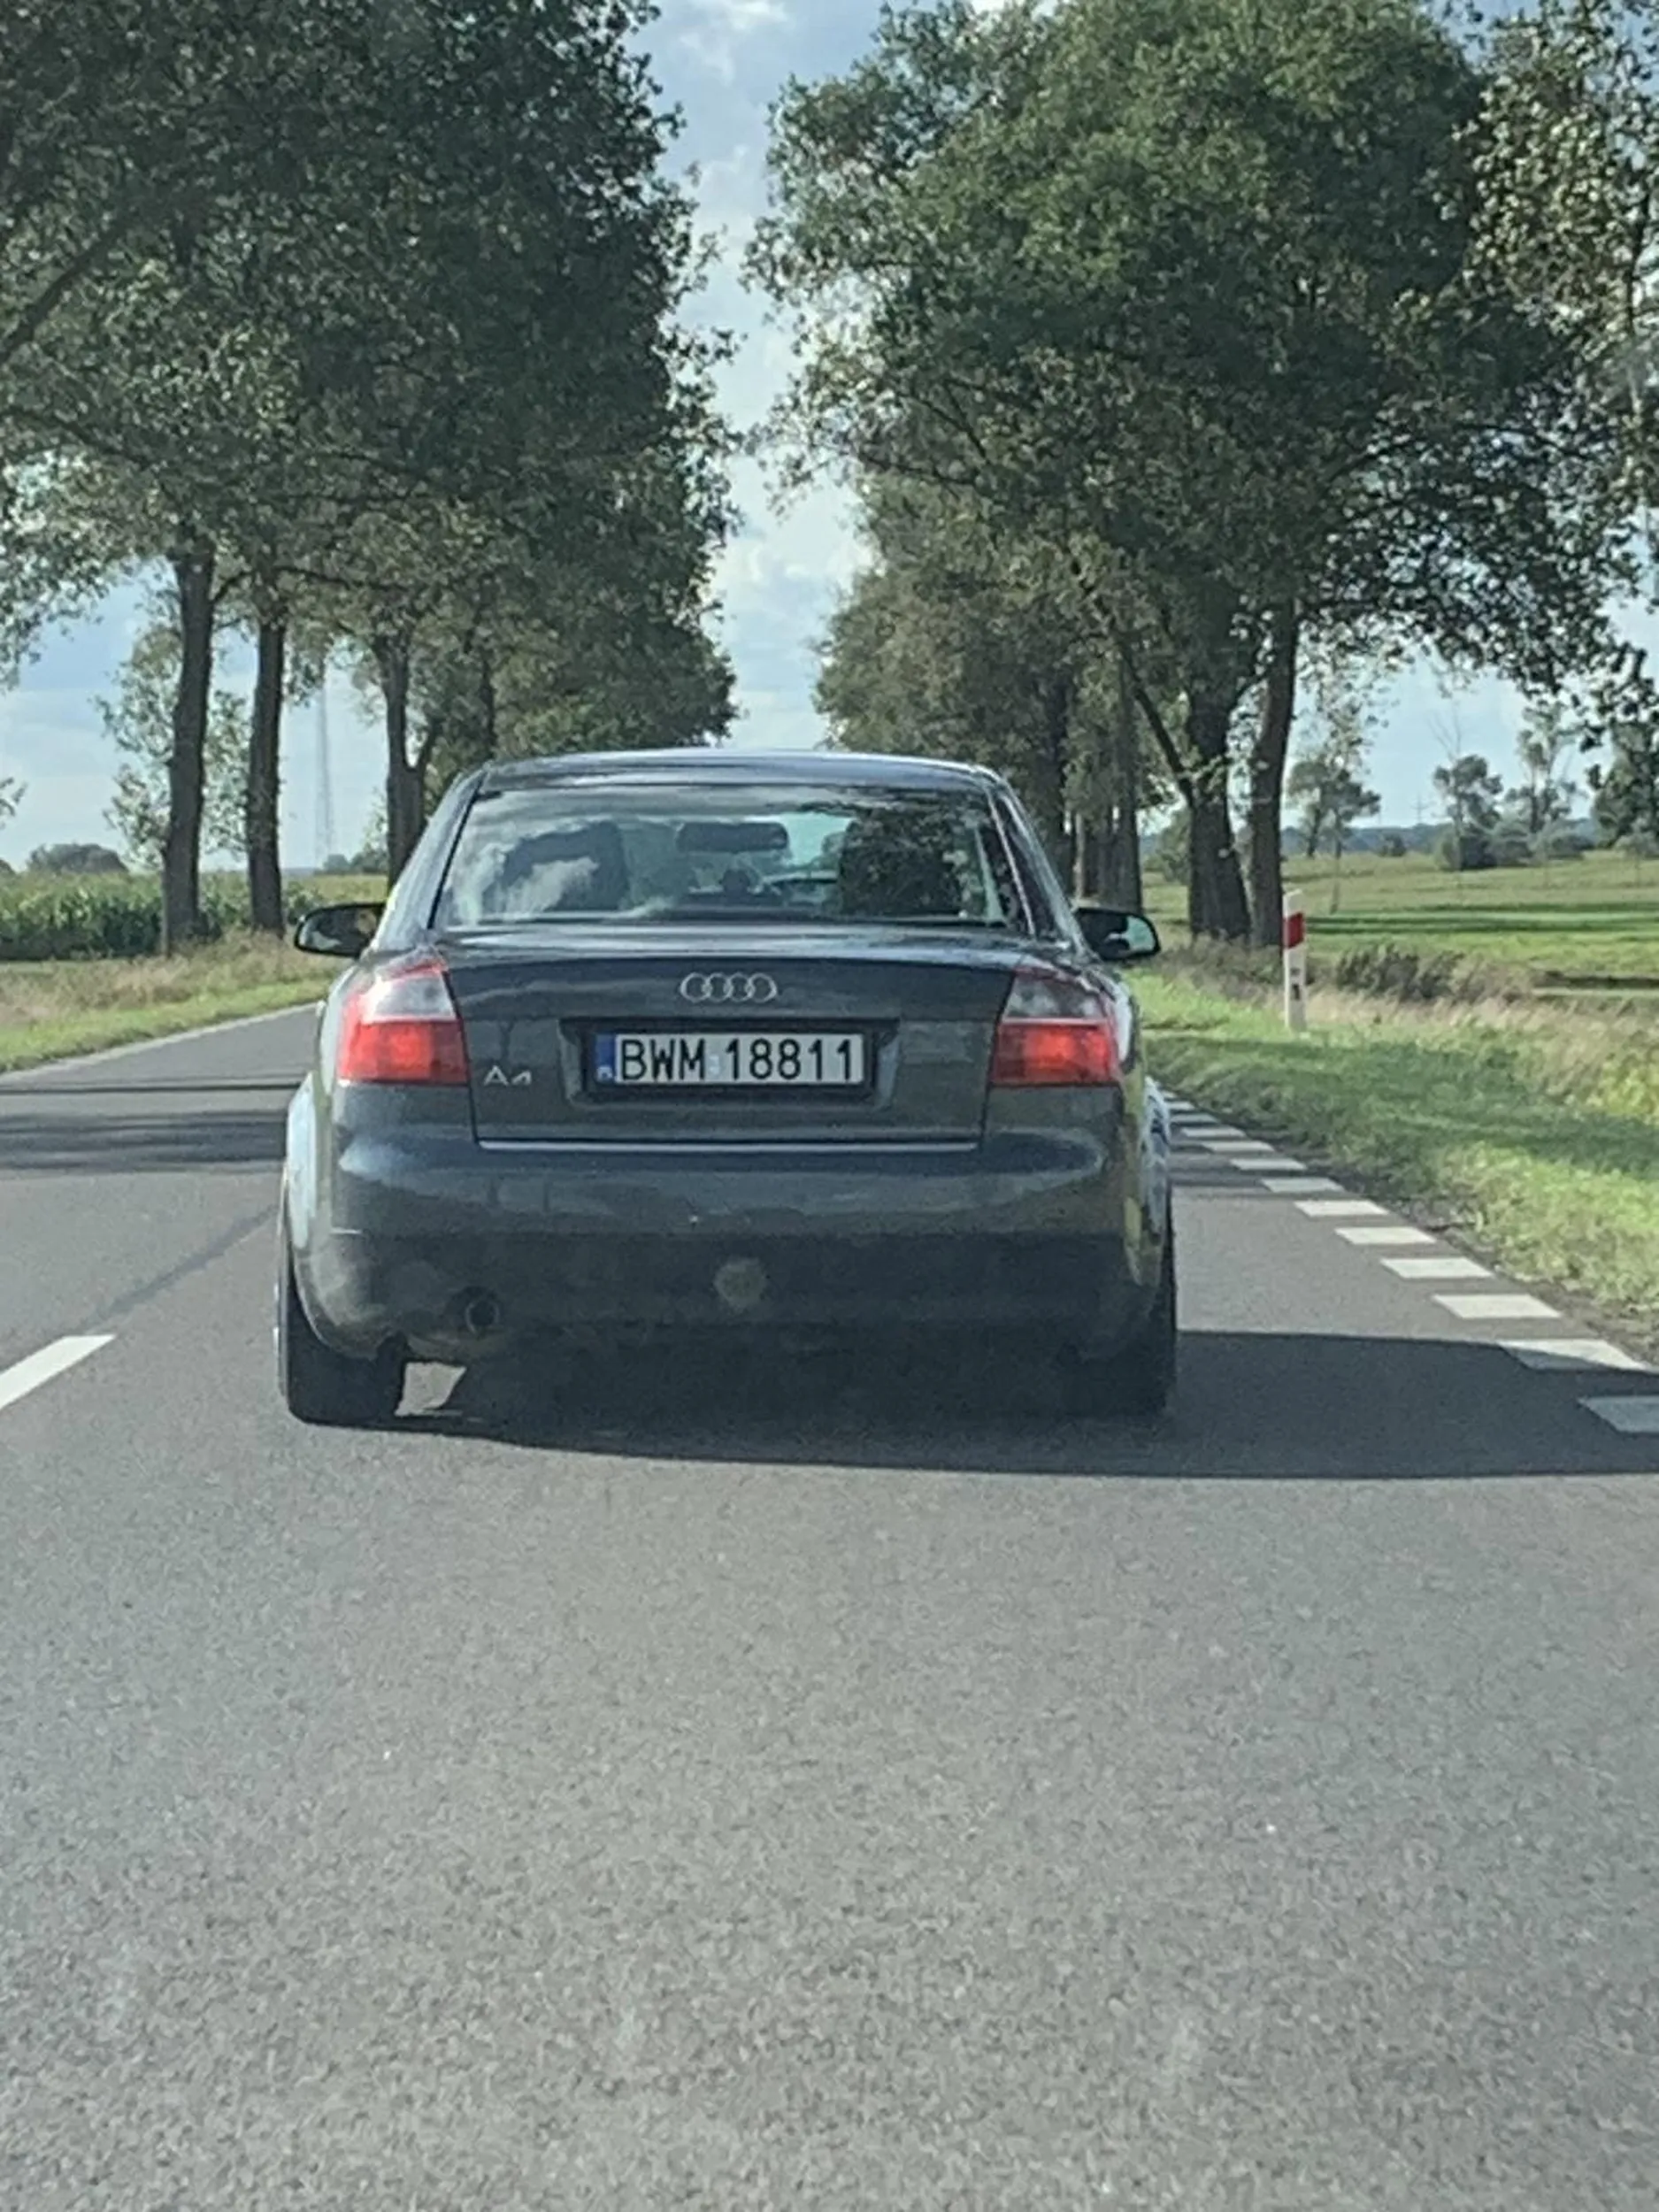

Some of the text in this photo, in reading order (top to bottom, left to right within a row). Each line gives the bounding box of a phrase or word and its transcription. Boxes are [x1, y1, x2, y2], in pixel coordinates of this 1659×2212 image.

[482, 1064, 532, 1086] A4
[621, 1039, 851, 1080] BWM 18811
